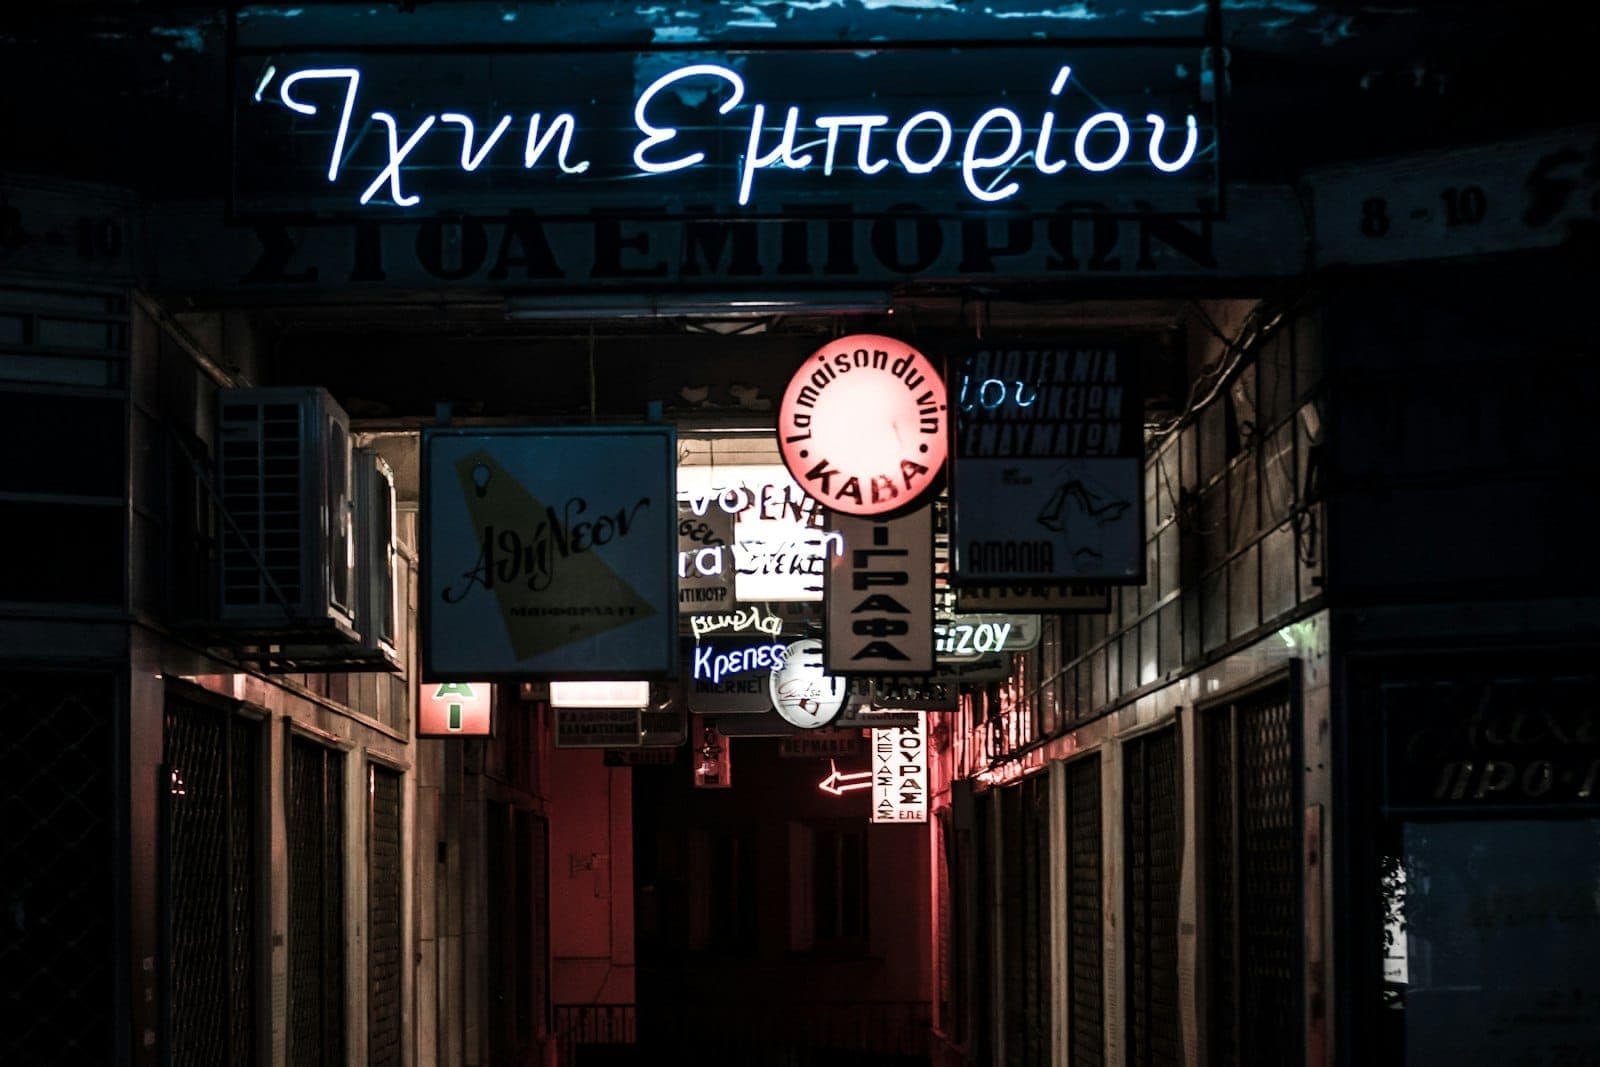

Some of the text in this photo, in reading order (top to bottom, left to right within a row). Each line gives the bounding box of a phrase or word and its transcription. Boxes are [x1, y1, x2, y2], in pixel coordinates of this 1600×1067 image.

[251, 61, 1200, 208] Ίχνη Εμπορίου
[1361, 196, 1391, 237] 8
[1441, 186, 1488, 228] 10
[796, 349, 888, 409] maison
[891, 354, 925, 391] du
[916, 390, 946, 434] vin
[804, 459, 930, 505] ΚΑΒΑ
[851, 514, 912, 661] ΙΓΡΑΦΑ
